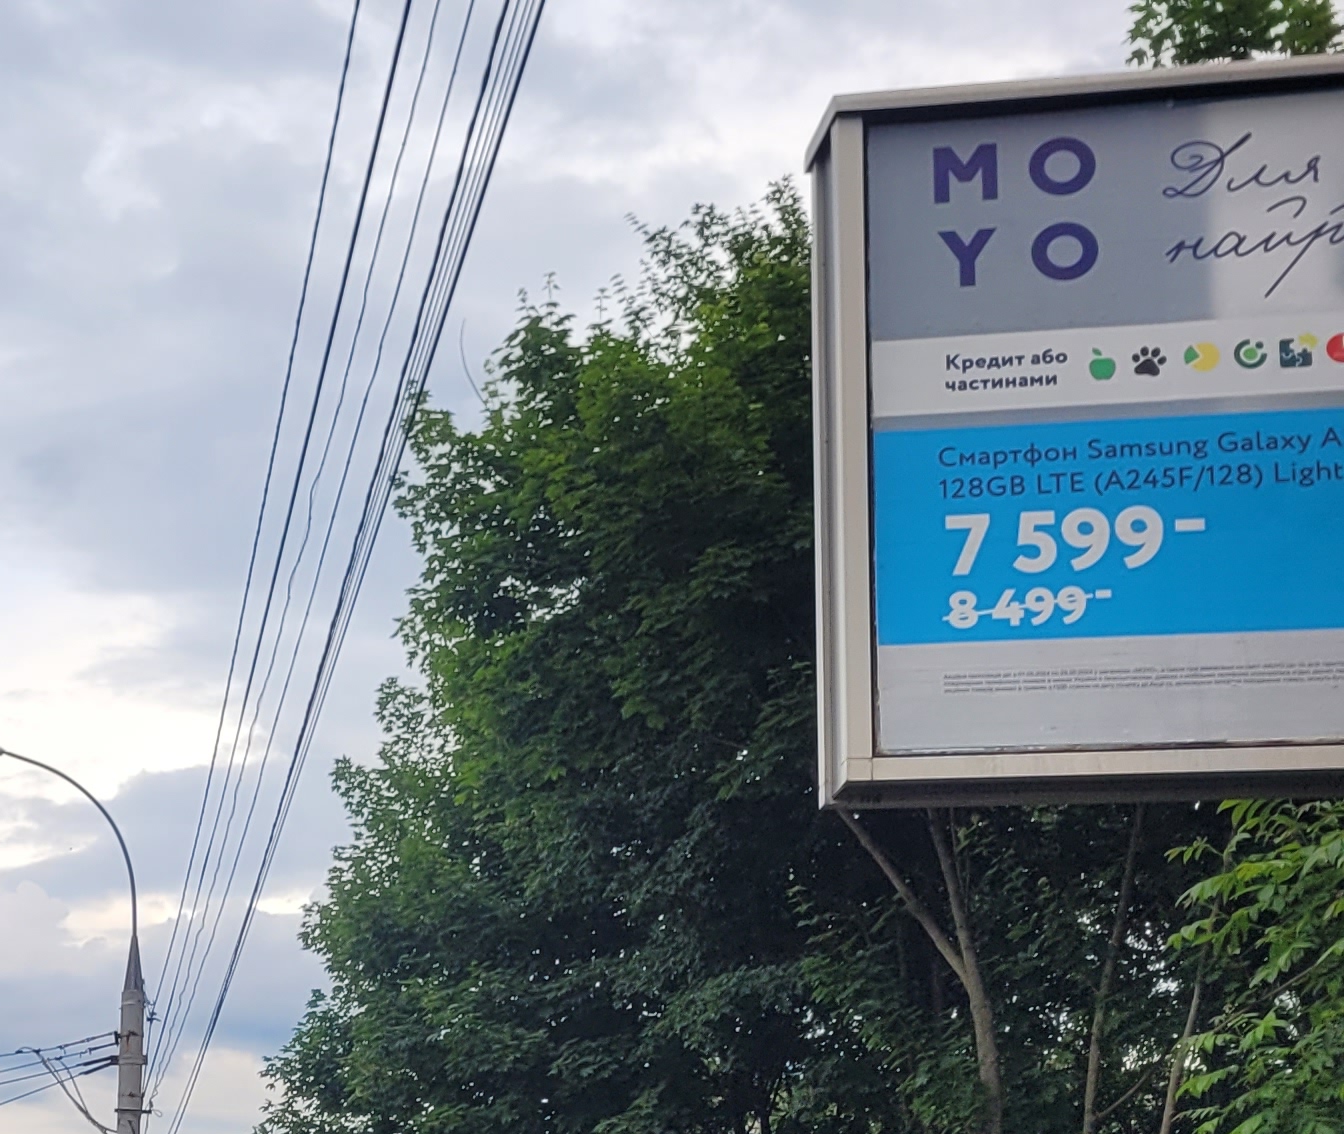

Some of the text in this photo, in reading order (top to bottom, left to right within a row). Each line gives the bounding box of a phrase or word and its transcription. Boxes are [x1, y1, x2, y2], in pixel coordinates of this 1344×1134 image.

[1162, 132, 1321, 198] Для
[1165, 196, 1344, 298] найр
[945, 348, 1068, 374] Кредит або
[945, 374, 1057, 392] частинами
[938, 443, 1077, 469] Смартфон
[1087, 438, 1208, 460] Samsung
[1218, 430, 1311, 454] Galaxy
[939, 460, 1344, 499] 128GB LTE (A245F/128) Light
[945, 513, 990, 576] 7
